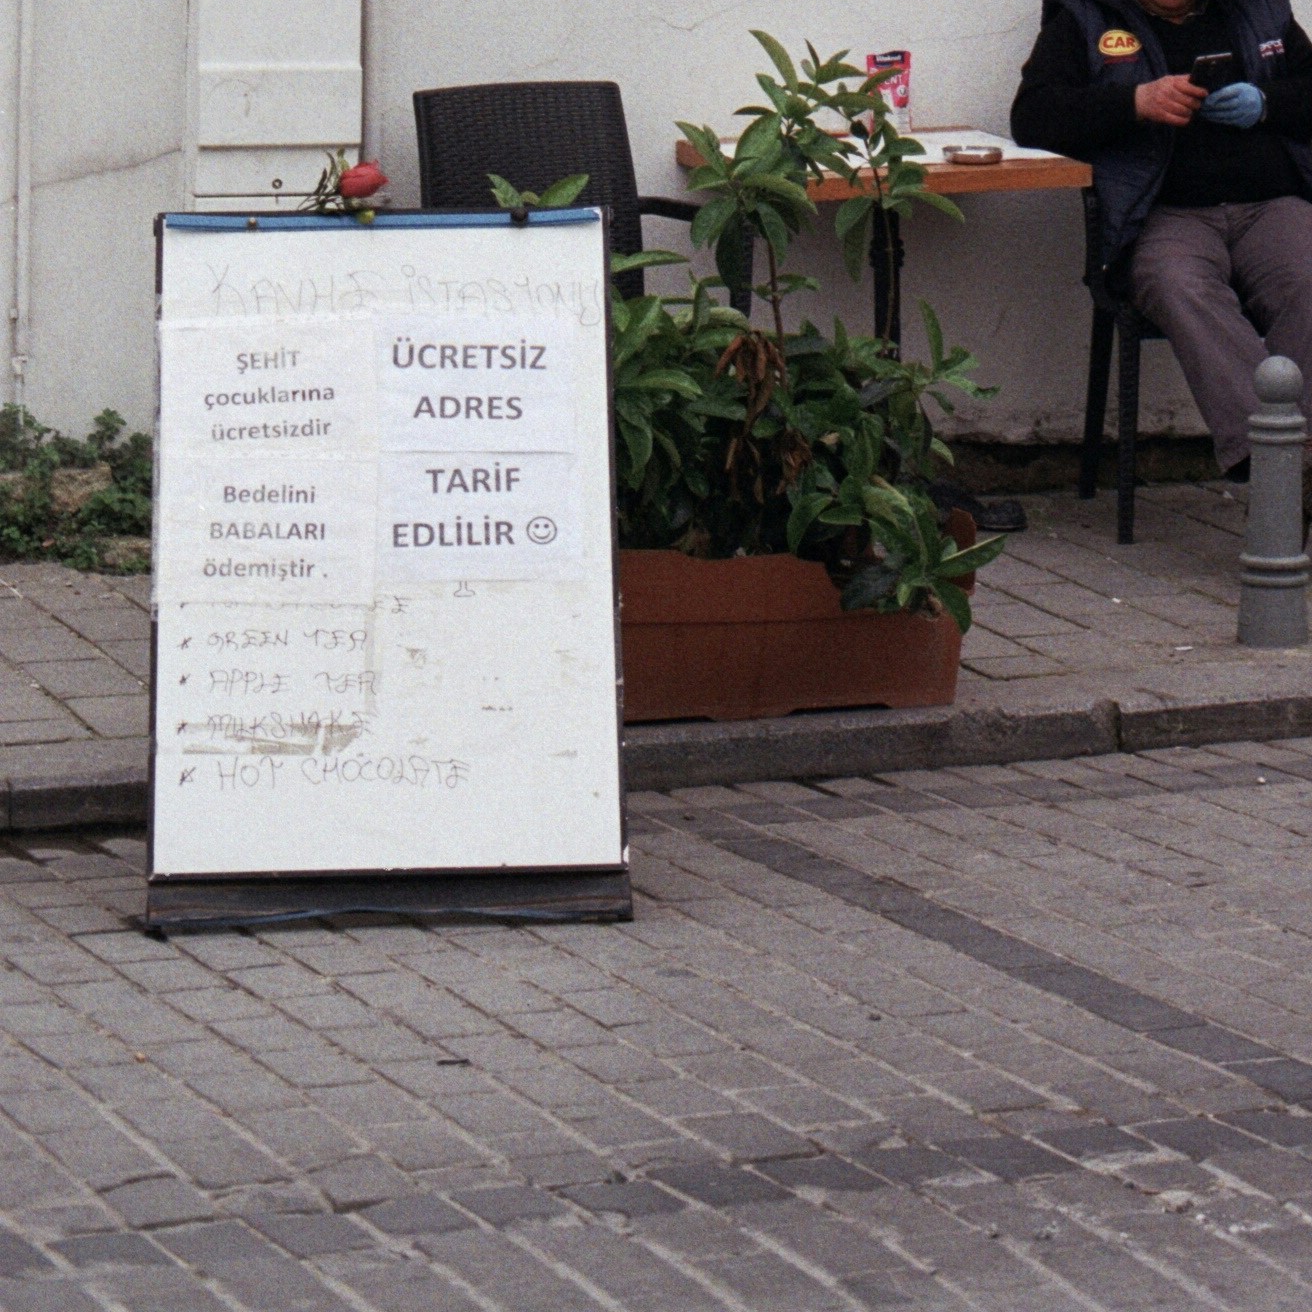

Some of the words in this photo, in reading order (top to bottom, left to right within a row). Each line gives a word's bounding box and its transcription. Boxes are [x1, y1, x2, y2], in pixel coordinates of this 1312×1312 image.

[1102, 36, 1136, 49] CAR
[236, 347, 300, 374] ŞEHİT
[392, 336, 547, 370] ÜCRETSİZ
[204, 386, 335, 411] çocuklarına
[413, 395, 524, 420] ADRES
[211, 418, 332, 441] ücretsizdir
[425, 461, 521, 493] TARİF
[223, 484, 316, 503] Bedelini
[209, 522, 326, 540] BABALARI
[392, 515, 516, 548] EDLİLİR
[203, 558, 316, 582] ödemiştir
[206, 629, 290, 652] GREEN
[303, 629, 369, 652] TEA
[209, 669, 292, 696] APPLE
[315, 670, 378, 696] TEA
[217, 756, 285, 791] HOT
[301, 755, 471, 789] CHOCOLATE
